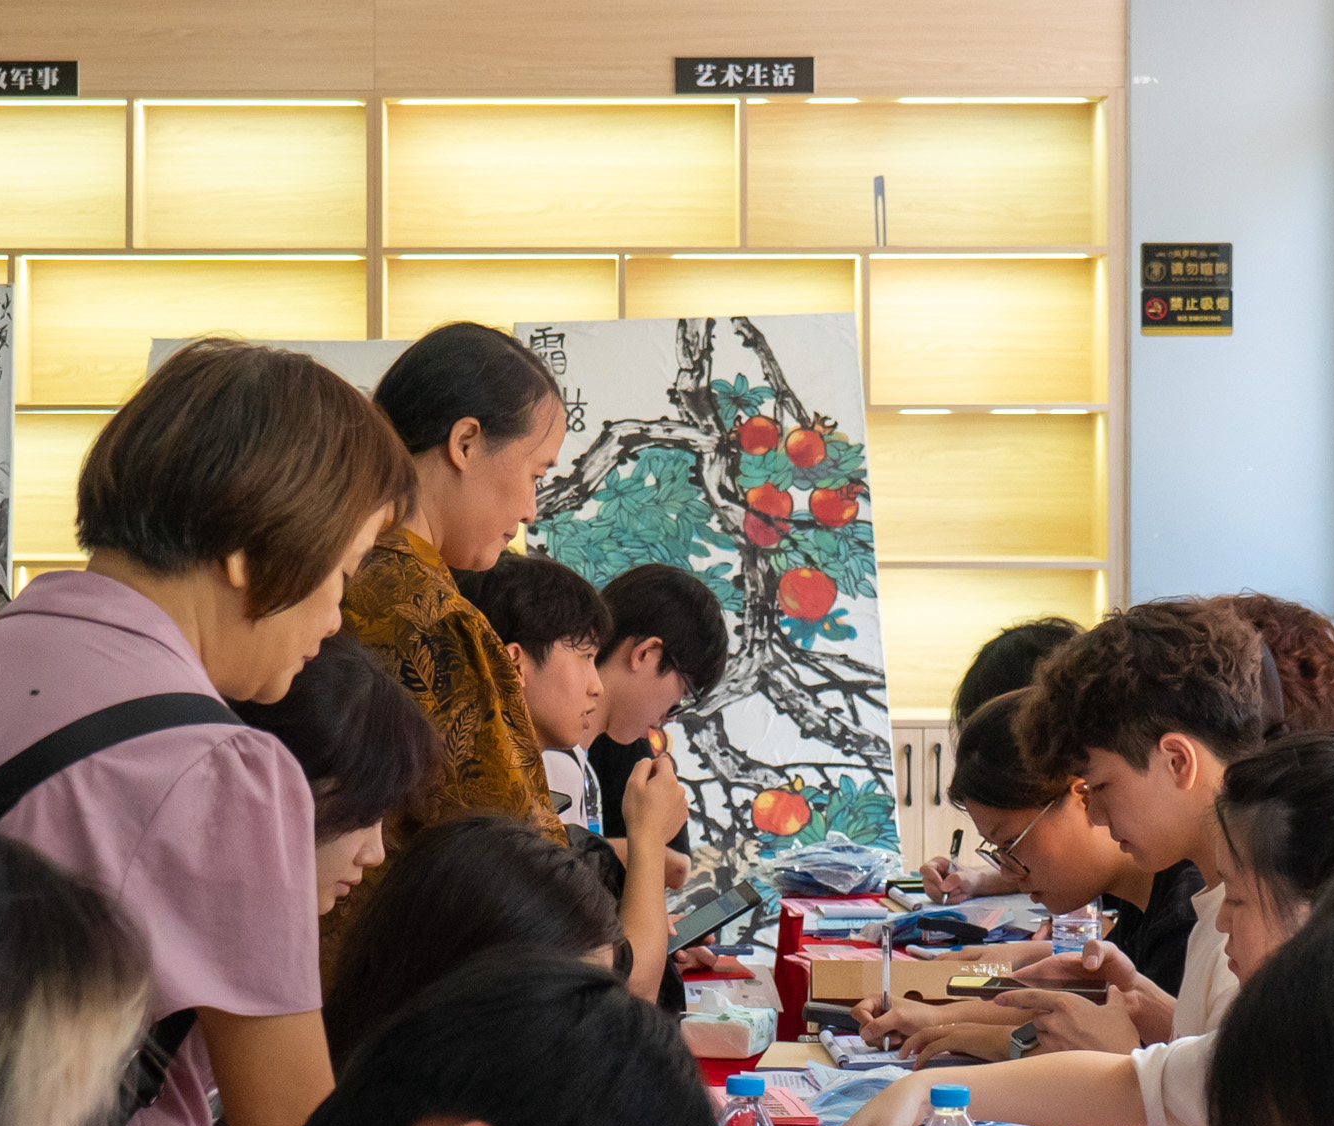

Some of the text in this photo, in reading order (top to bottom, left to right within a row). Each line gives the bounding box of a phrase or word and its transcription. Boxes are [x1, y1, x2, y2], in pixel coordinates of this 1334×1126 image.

[694, 63, 796, 88] 艺术生活
[1169, 296, 1230, 311] 禁止吸烟
